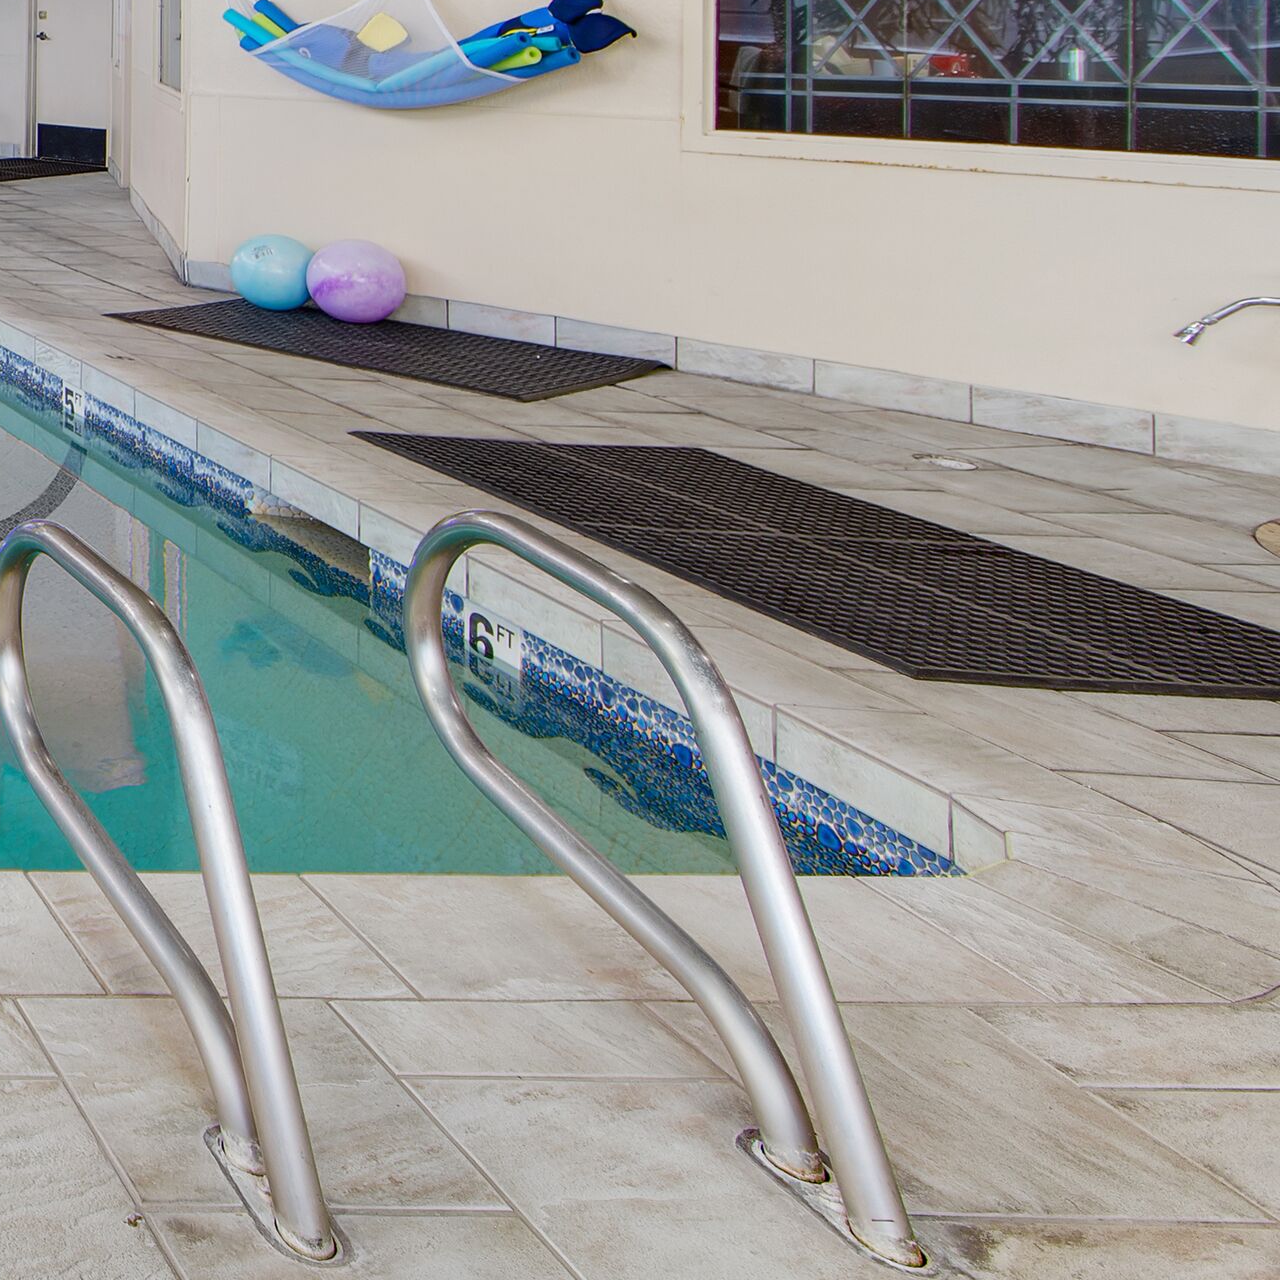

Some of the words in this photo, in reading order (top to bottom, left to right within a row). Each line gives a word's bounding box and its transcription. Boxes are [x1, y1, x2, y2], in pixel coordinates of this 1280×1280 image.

[64, 387, 74, 417] 5
[469, 612, 494, 659] 6
[497, 623, 515, 648] FT
